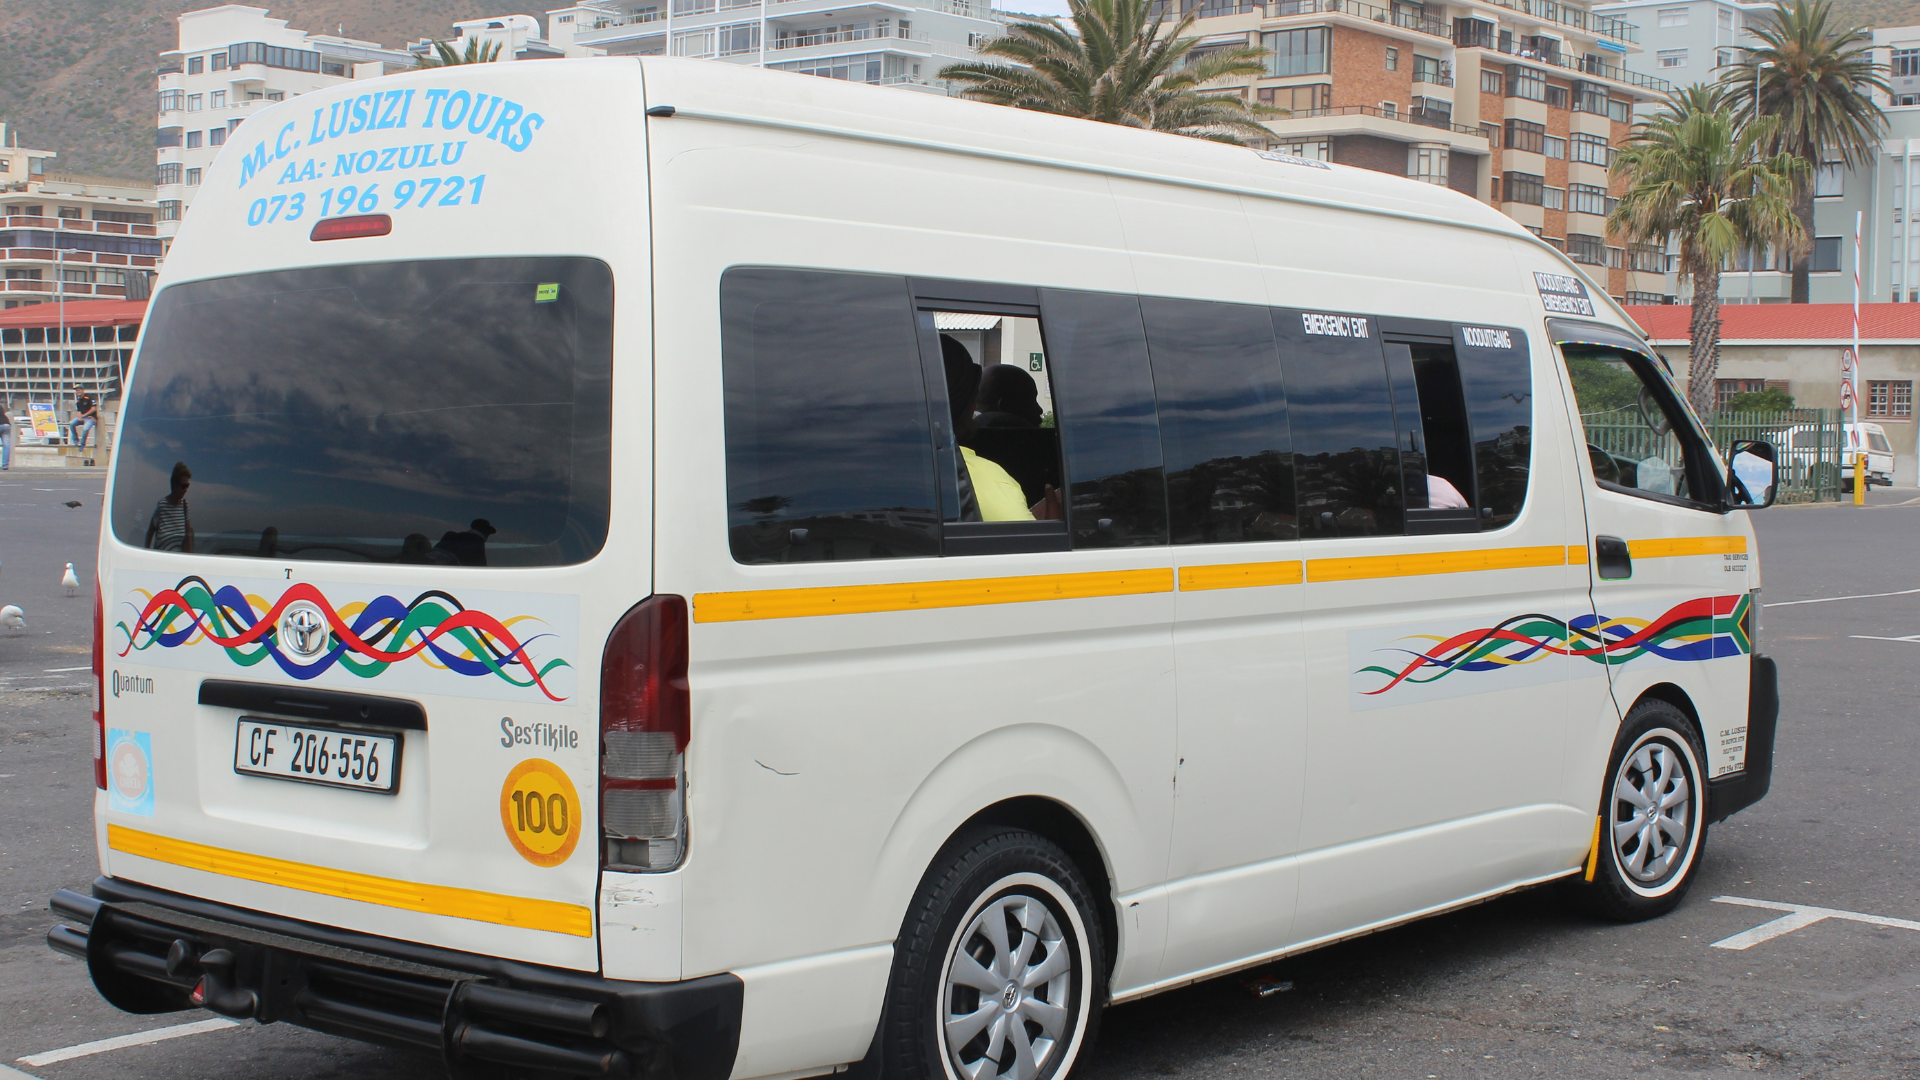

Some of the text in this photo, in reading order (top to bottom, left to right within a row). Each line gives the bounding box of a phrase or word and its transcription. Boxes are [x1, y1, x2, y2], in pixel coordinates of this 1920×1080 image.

[238, 88, 546, 190] M.C. LUSIZI TOURS
[277, 140, 468, 185] AA: NOZULU
[246, 174, 487, 227] 073 196 9721
[1541, 293, 1593, 315] EMERGENCY EXIT
[1302, 313, 1369, 339] EMERGENCY EXIT
[1462, 326, 1512, 349] NOODUITGANG
[284, 568, 293, 580] T
[112, 669, 154, 698] Quantum
[249, 727, 278, 767] CF
[511, 789, 569, 836] 100
